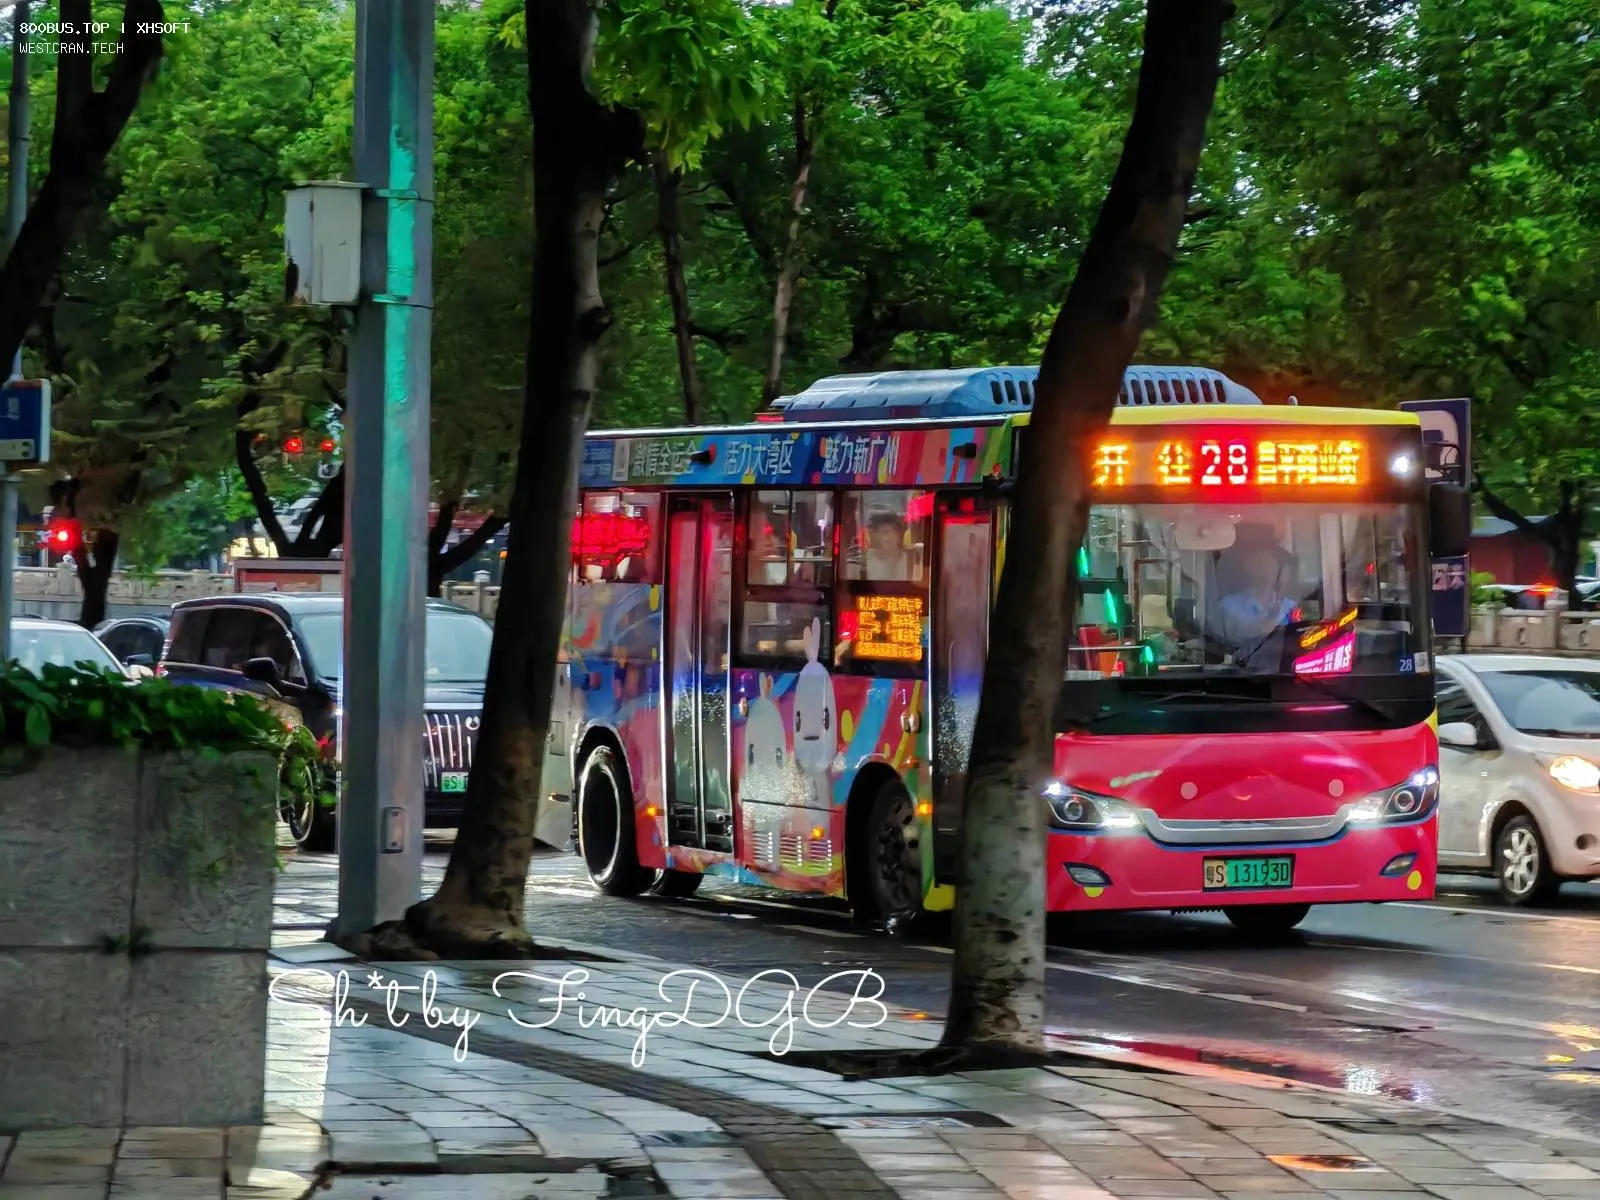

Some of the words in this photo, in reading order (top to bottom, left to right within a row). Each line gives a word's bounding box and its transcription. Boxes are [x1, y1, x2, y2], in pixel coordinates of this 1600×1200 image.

[726, 438, 795, 475] 活力大湾区
[822, 435, 900, 477] 魅力新广州
[1201, 442, 1249, 485] 28
[1399, 658, 1413, 671] 28
